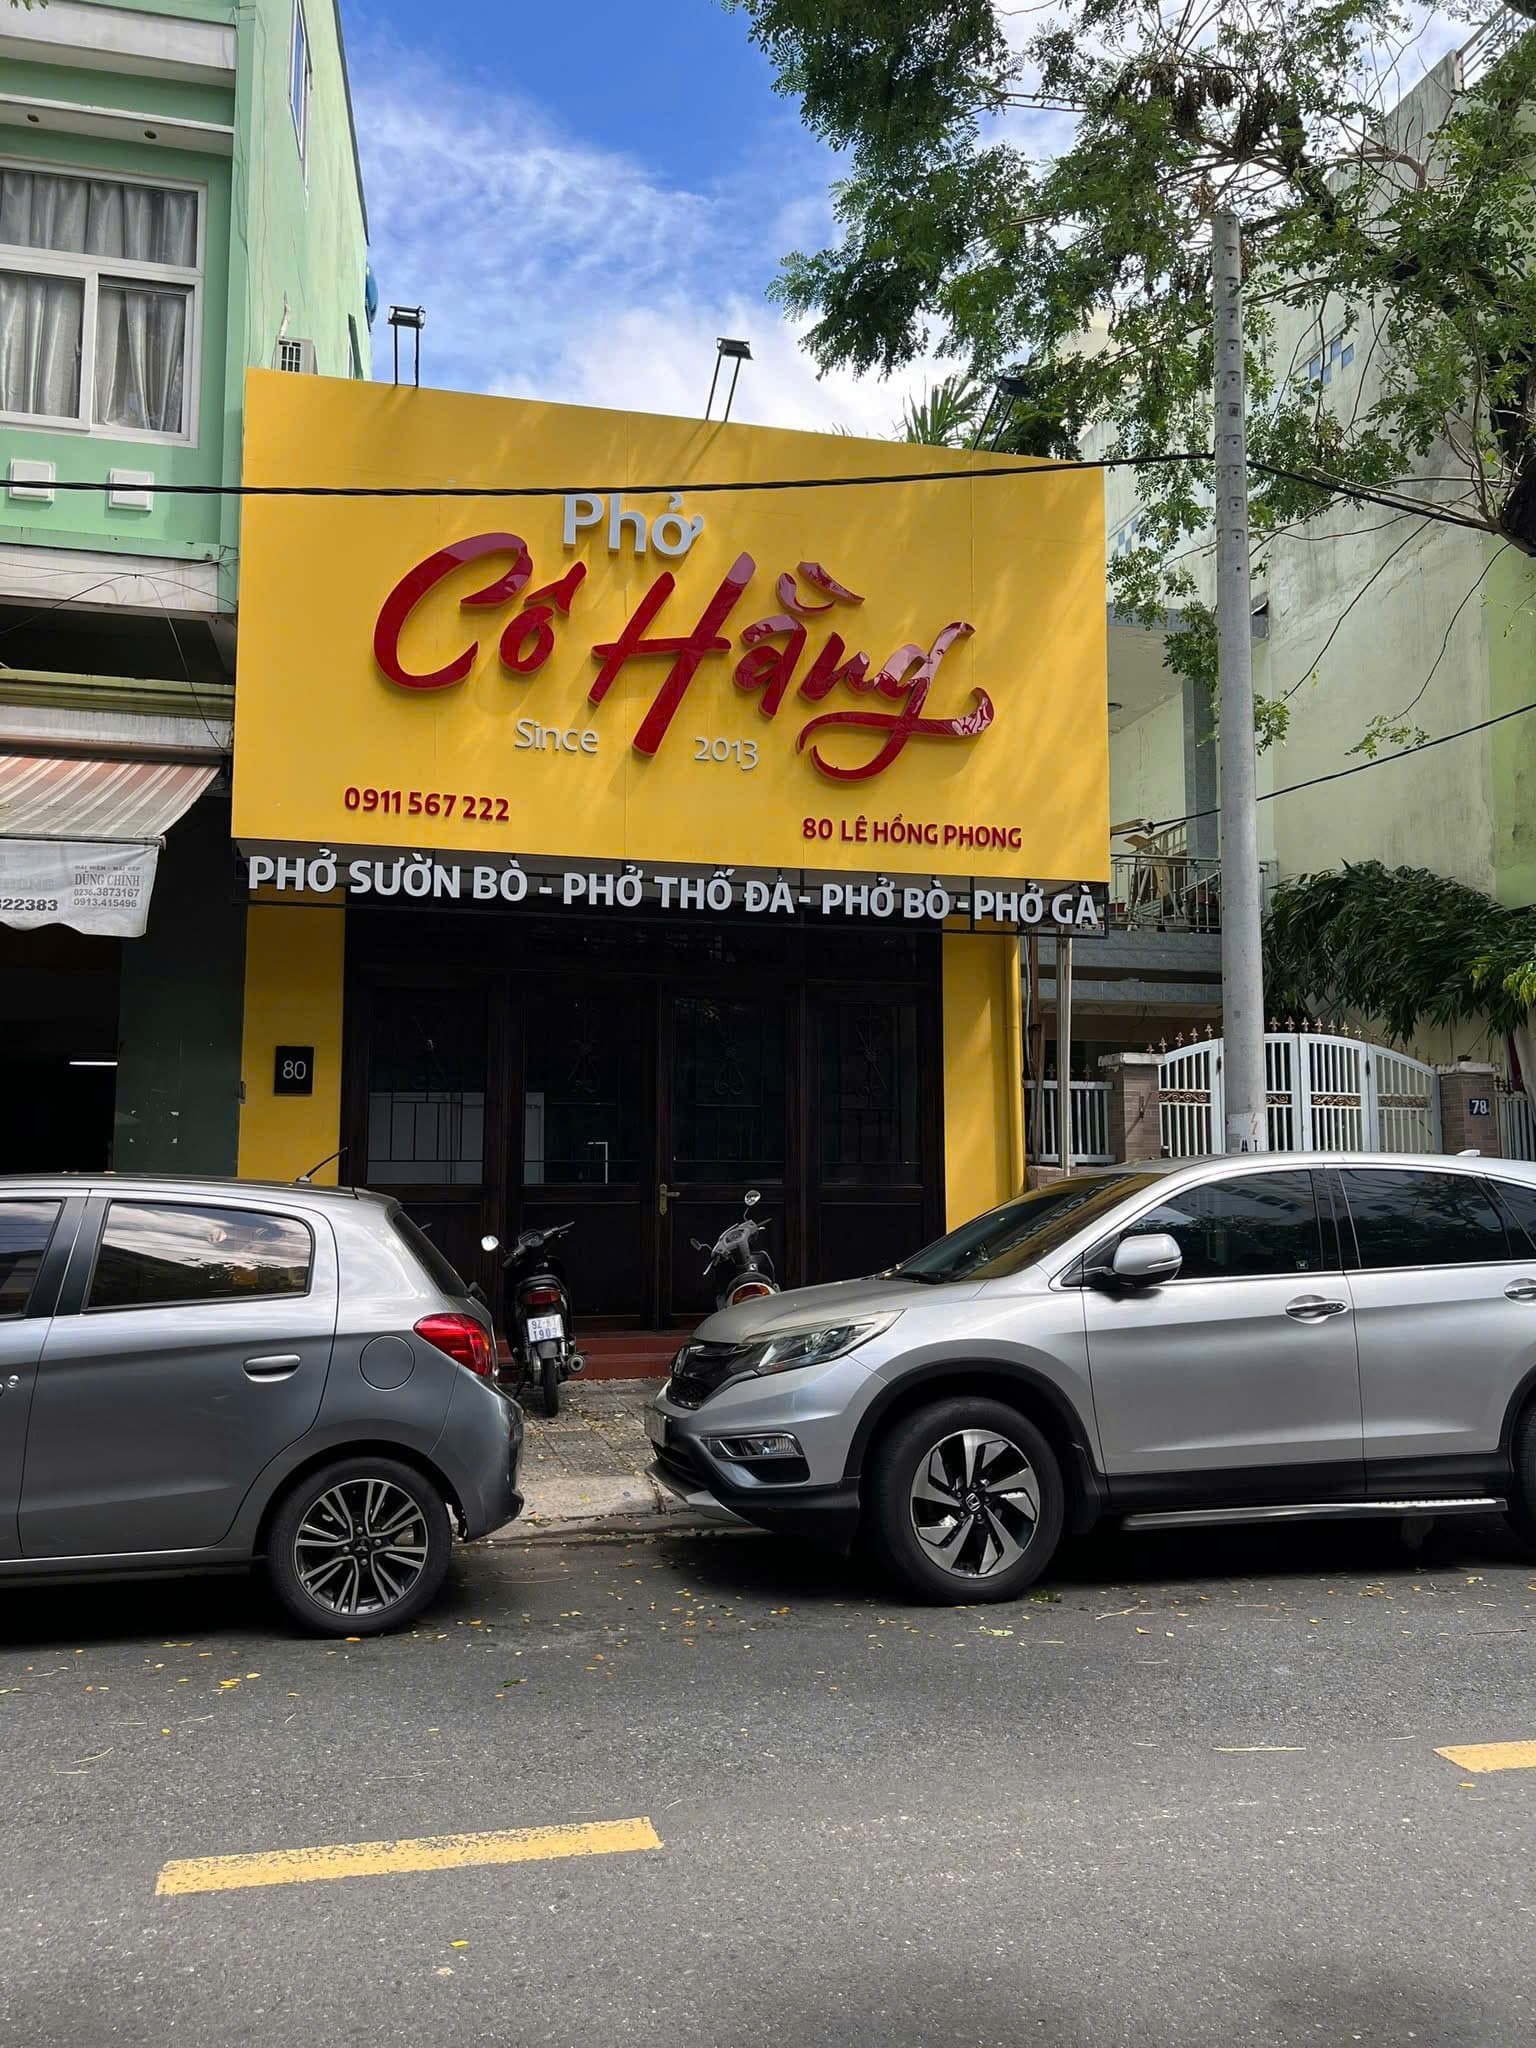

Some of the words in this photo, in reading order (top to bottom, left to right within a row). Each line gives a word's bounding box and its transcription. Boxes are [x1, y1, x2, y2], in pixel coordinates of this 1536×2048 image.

[563, 492, 704, 556] Phở
[588, 552, 994, 782] Hằng
[514, 718, 600, 753] Since
[694, 736, 760, 771] 2013
[344, 787, 402, 815] 0911
[407, 792, 457, 818] 567
[462, 796, 510, 822] 222
[802, 817, 834, 840] 80
[841, 815, 868, 842] LÊ
[873, 812, 938, 846] HỒNG
[943, 825, 1022, 849] PHONG
[0, 898, 58, 911] 22383
[248, 848, 338, 893] PHỞ
[349, 852, 461, 898] SƯỜN
[472, 860, 528, 902] BÒ
[563, 864, 643, 908] PHỞ
[654, 868, 735, 911] THỐ
[822, 877, 895, 918] PHỞ
[903, 880, 950, 920] BÒ
[974, 882, 1044, 924] PHỞ
[1051, 884, 1099, 925] GÀ
[282, 1060, 307, 1080] 80
[1471, 1100, 1489, 1114] 78
